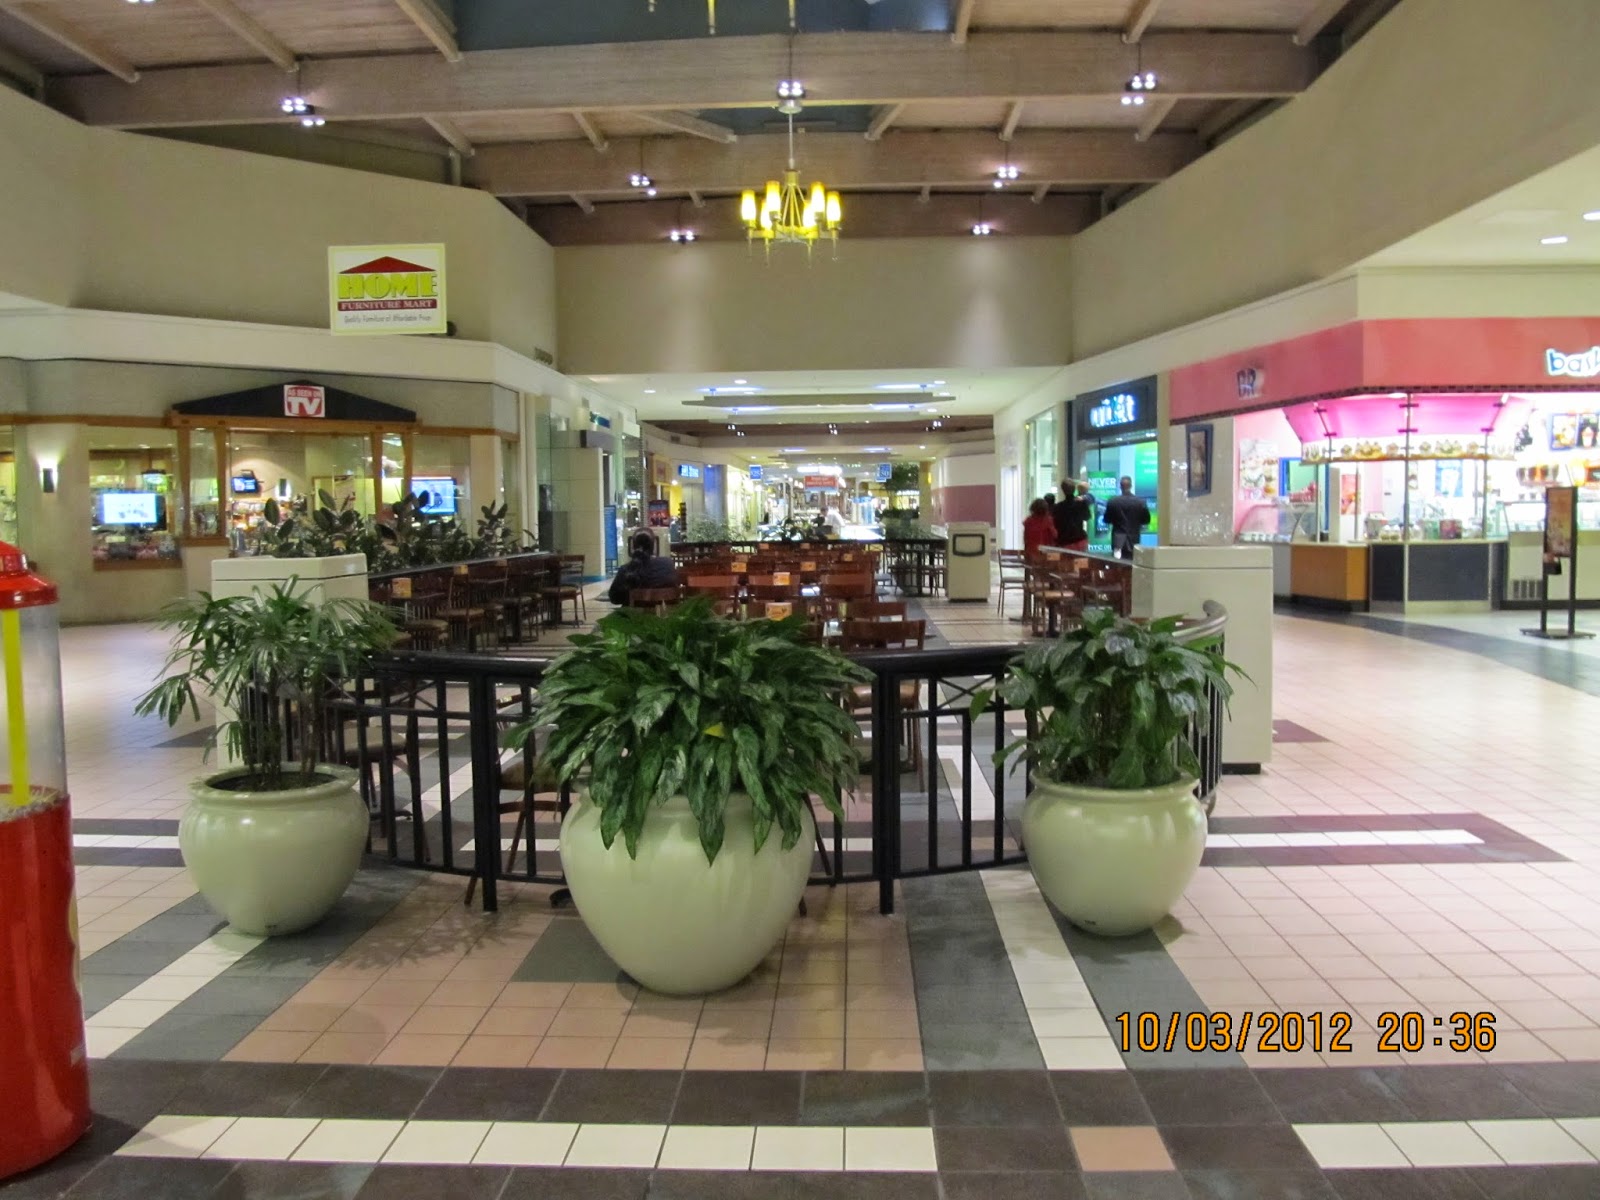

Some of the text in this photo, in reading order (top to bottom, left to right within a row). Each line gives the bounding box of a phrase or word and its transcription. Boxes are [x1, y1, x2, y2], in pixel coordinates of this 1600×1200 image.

[338, 273, 438, 299] HOME
[341, 300, 432, 310] FURNITURE MART
[287, 397, 321, 415] TV
[1088, 478, 1116, 489] NEVER
